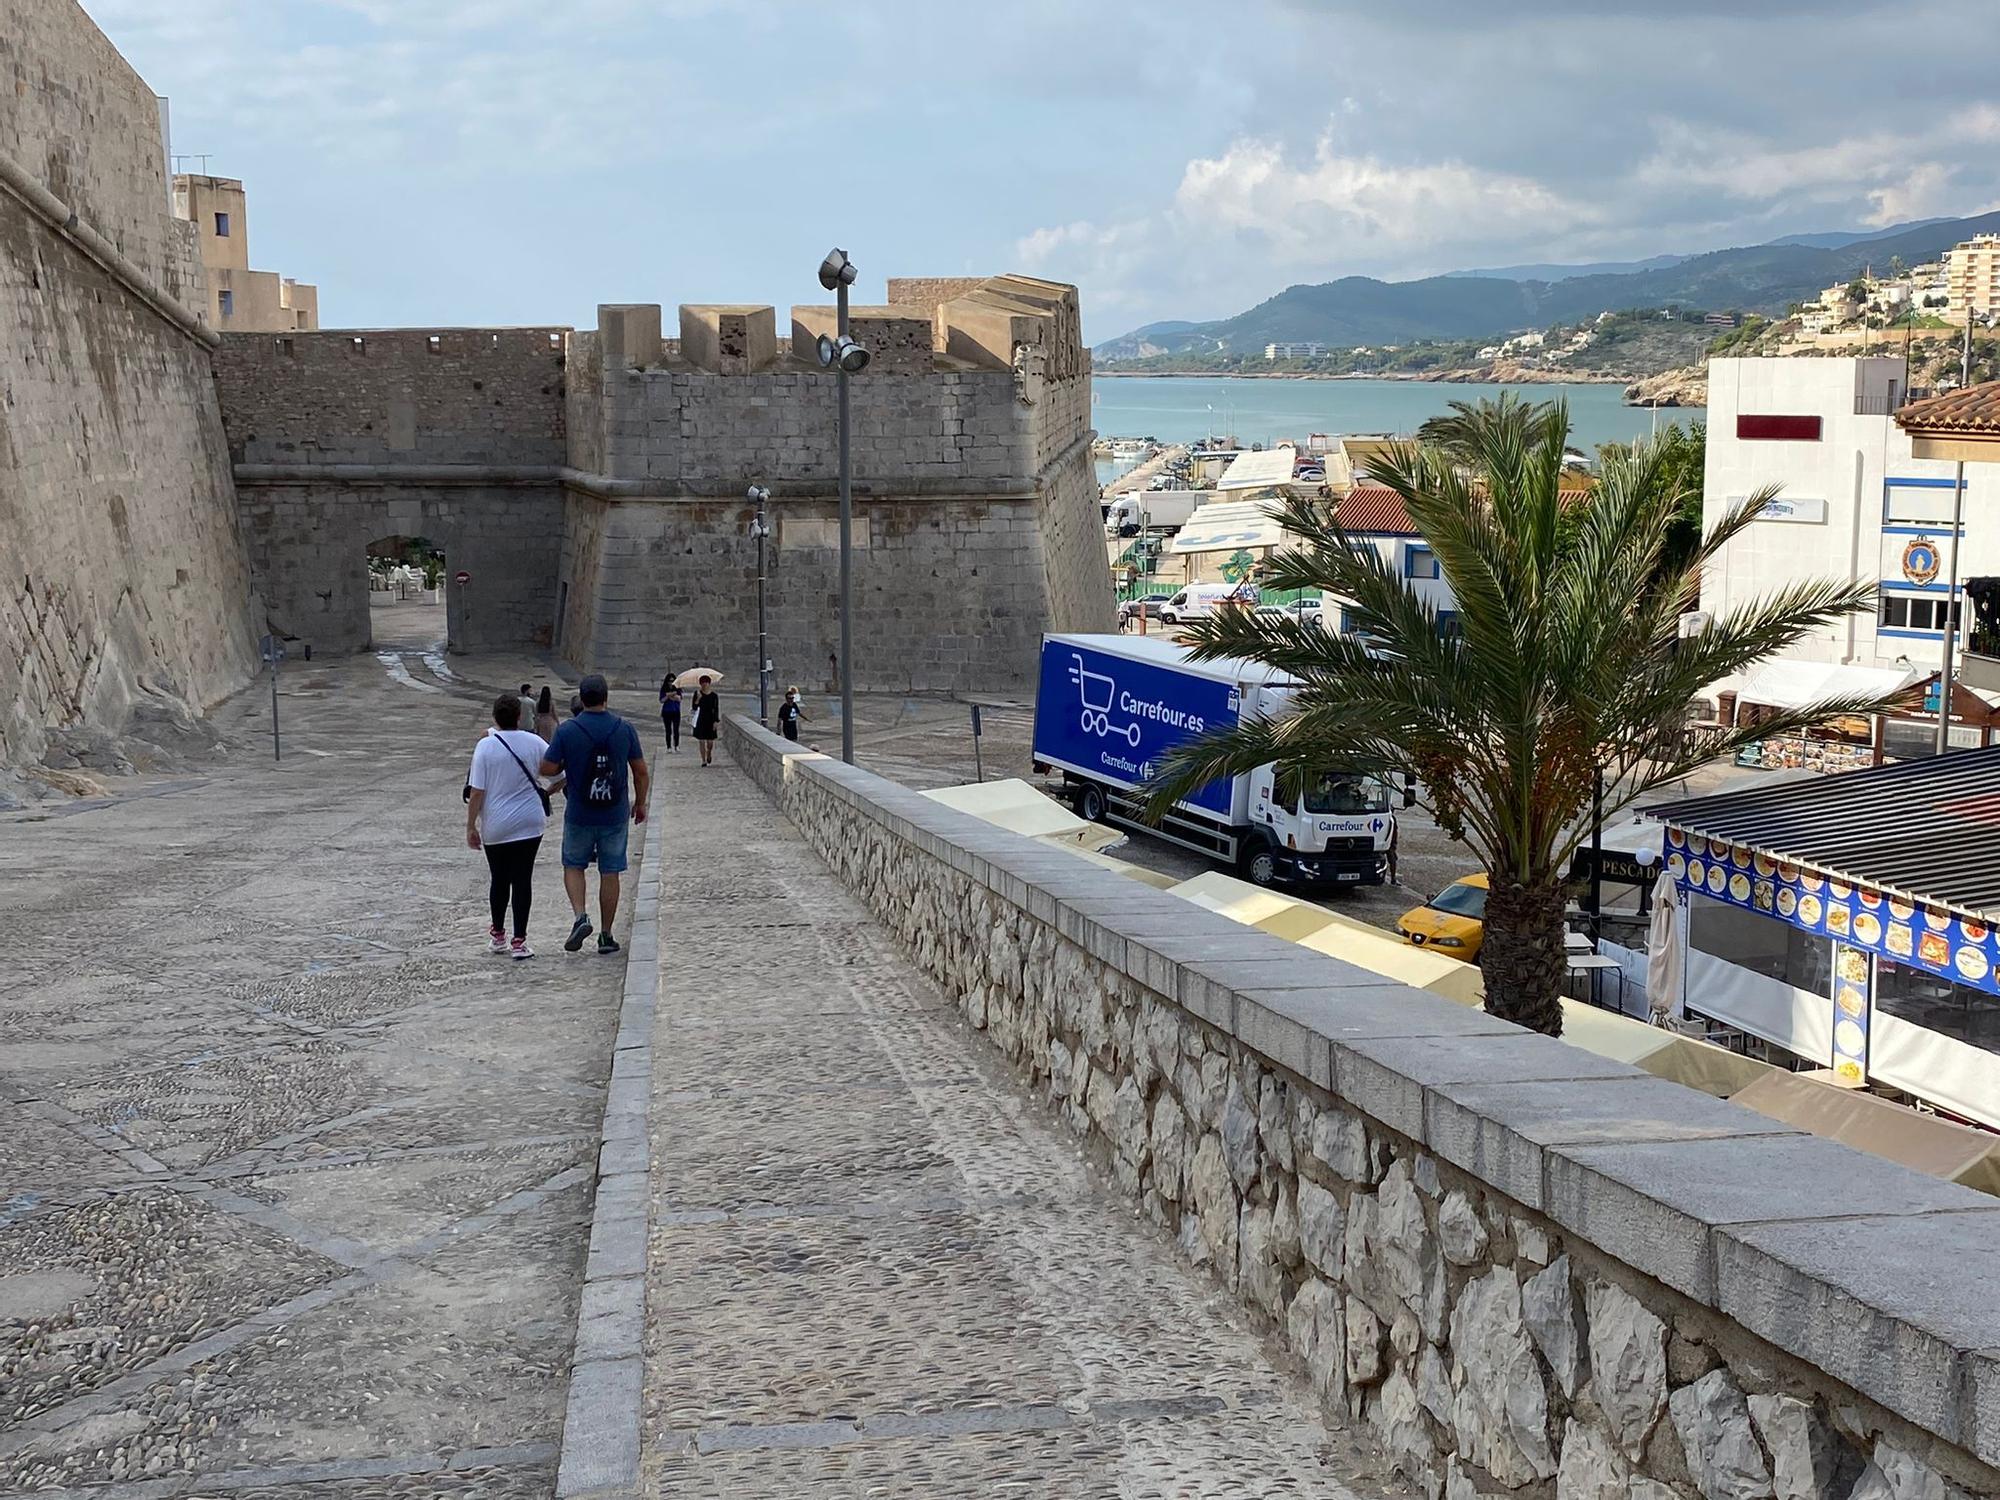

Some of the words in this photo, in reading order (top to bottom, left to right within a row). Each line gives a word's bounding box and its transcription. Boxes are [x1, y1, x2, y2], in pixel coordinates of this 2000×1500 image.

[1120, 691, 1204, 733] Carrefour.es
[1101, 751, 1137, 774] Carrefour
[1319, 820, 1364, 832] Carrefour
